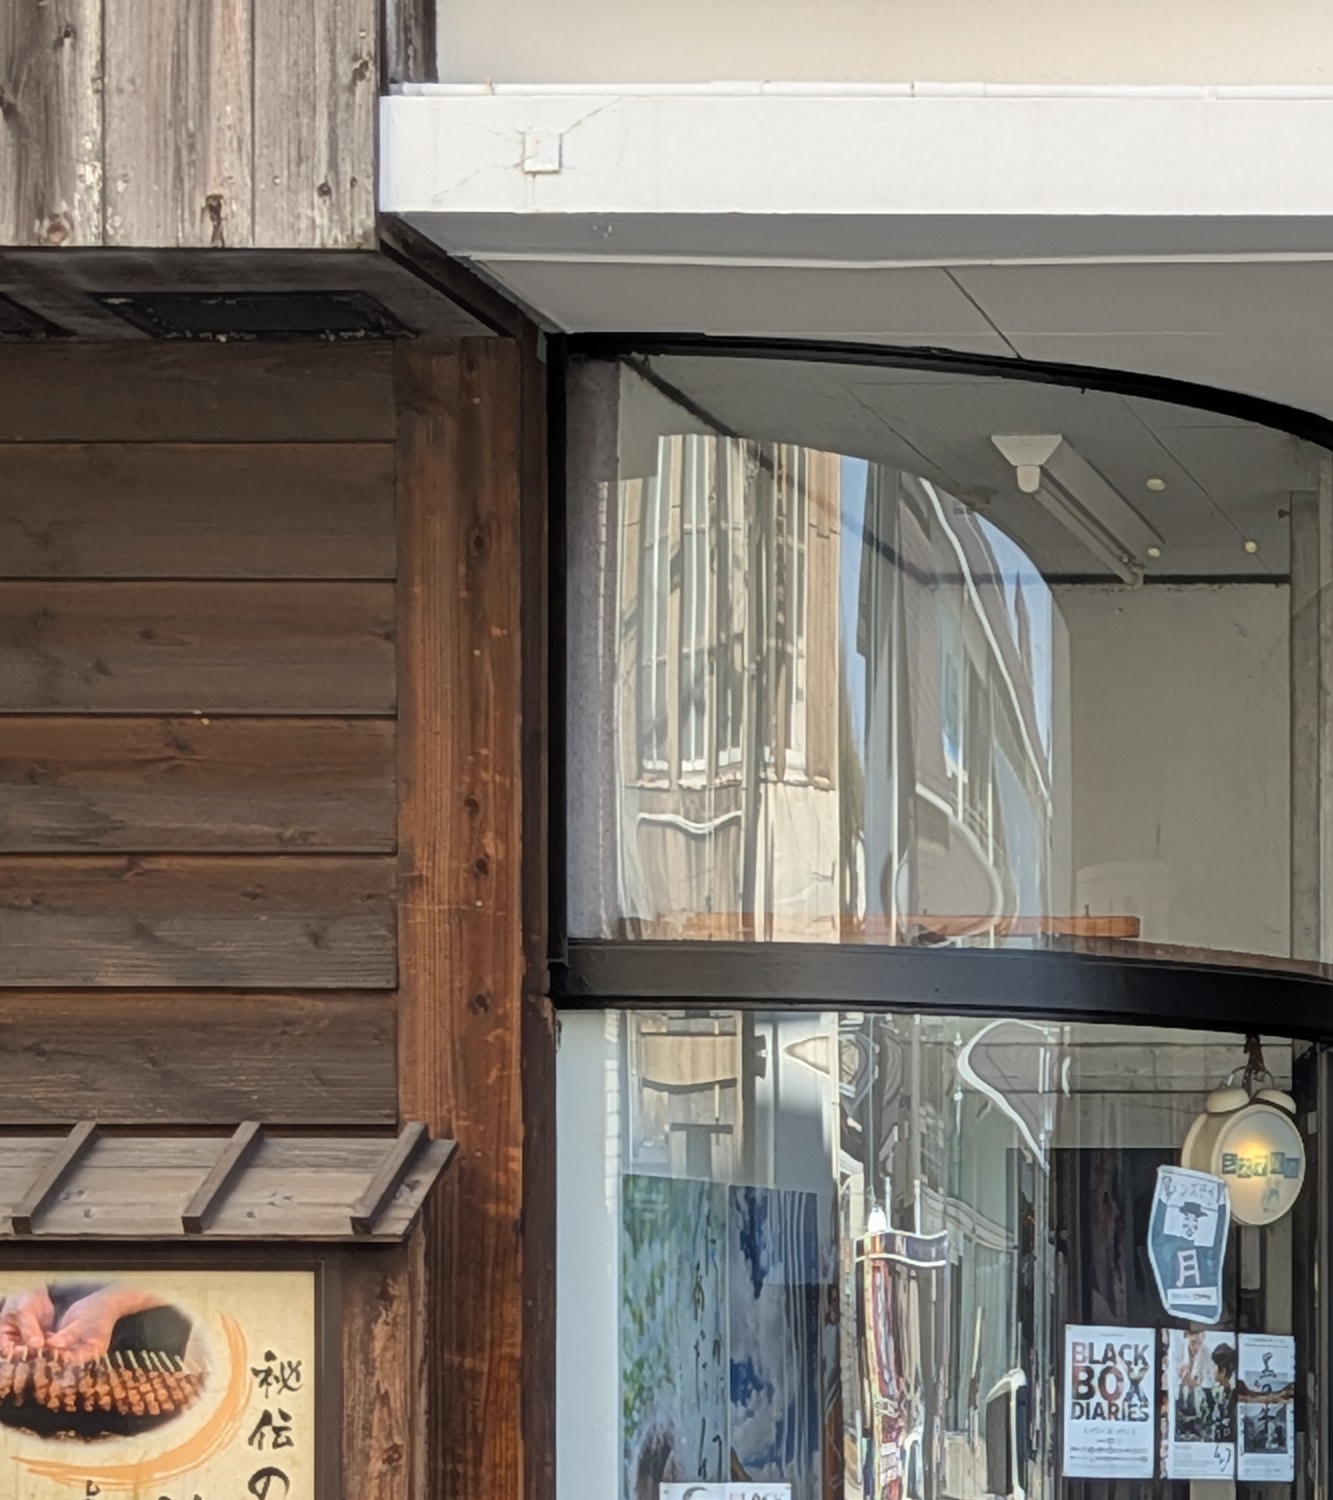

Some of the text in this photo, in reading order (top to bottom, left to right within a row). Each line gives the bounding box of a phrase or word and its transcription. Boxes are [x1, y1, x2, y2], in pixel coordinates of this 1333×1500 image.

[1071, 1341, 1150, 1366] BLACK
[1071, 1365, 1150, 1402] BOX
[1070, 1401, 1150, 1422] DIARIES
